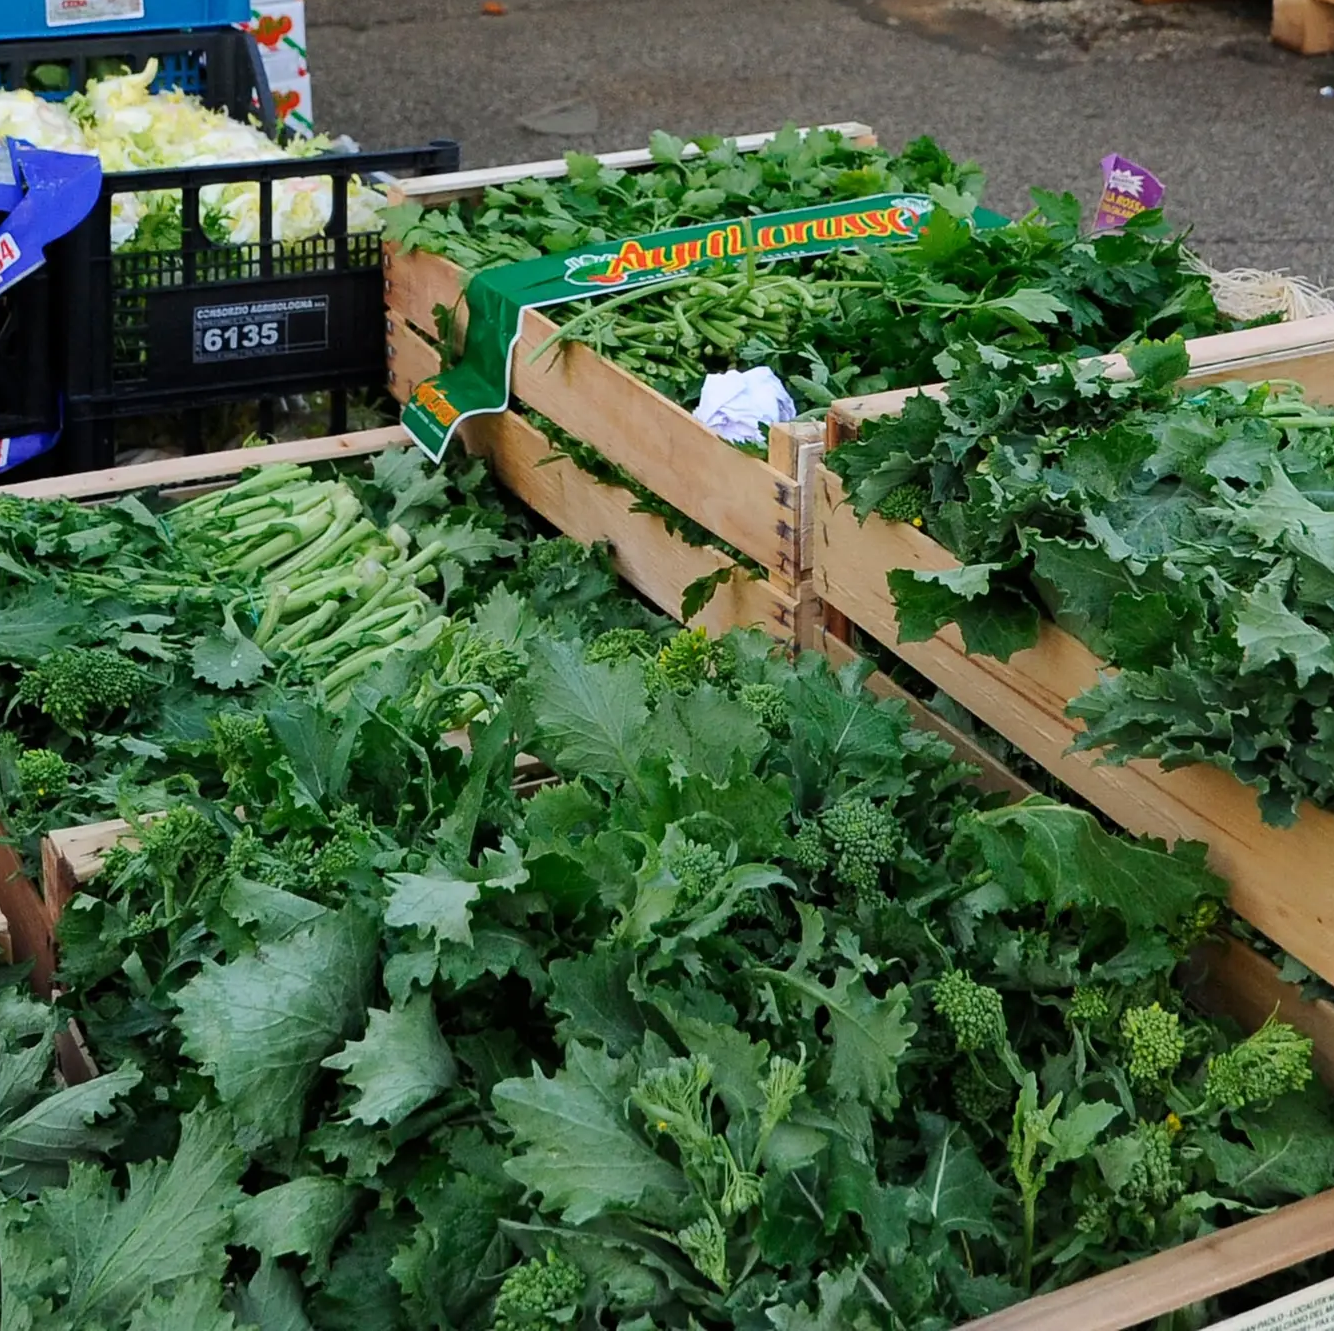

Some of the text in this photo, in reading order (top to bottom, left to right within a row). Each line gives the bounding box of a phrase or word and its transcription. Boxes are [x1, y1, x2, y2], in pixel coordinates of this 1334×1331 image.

[197, 300, 313, 319] CONSORZIO AGRIBOLOGNA
[203, 322, 279, 352] 6135
